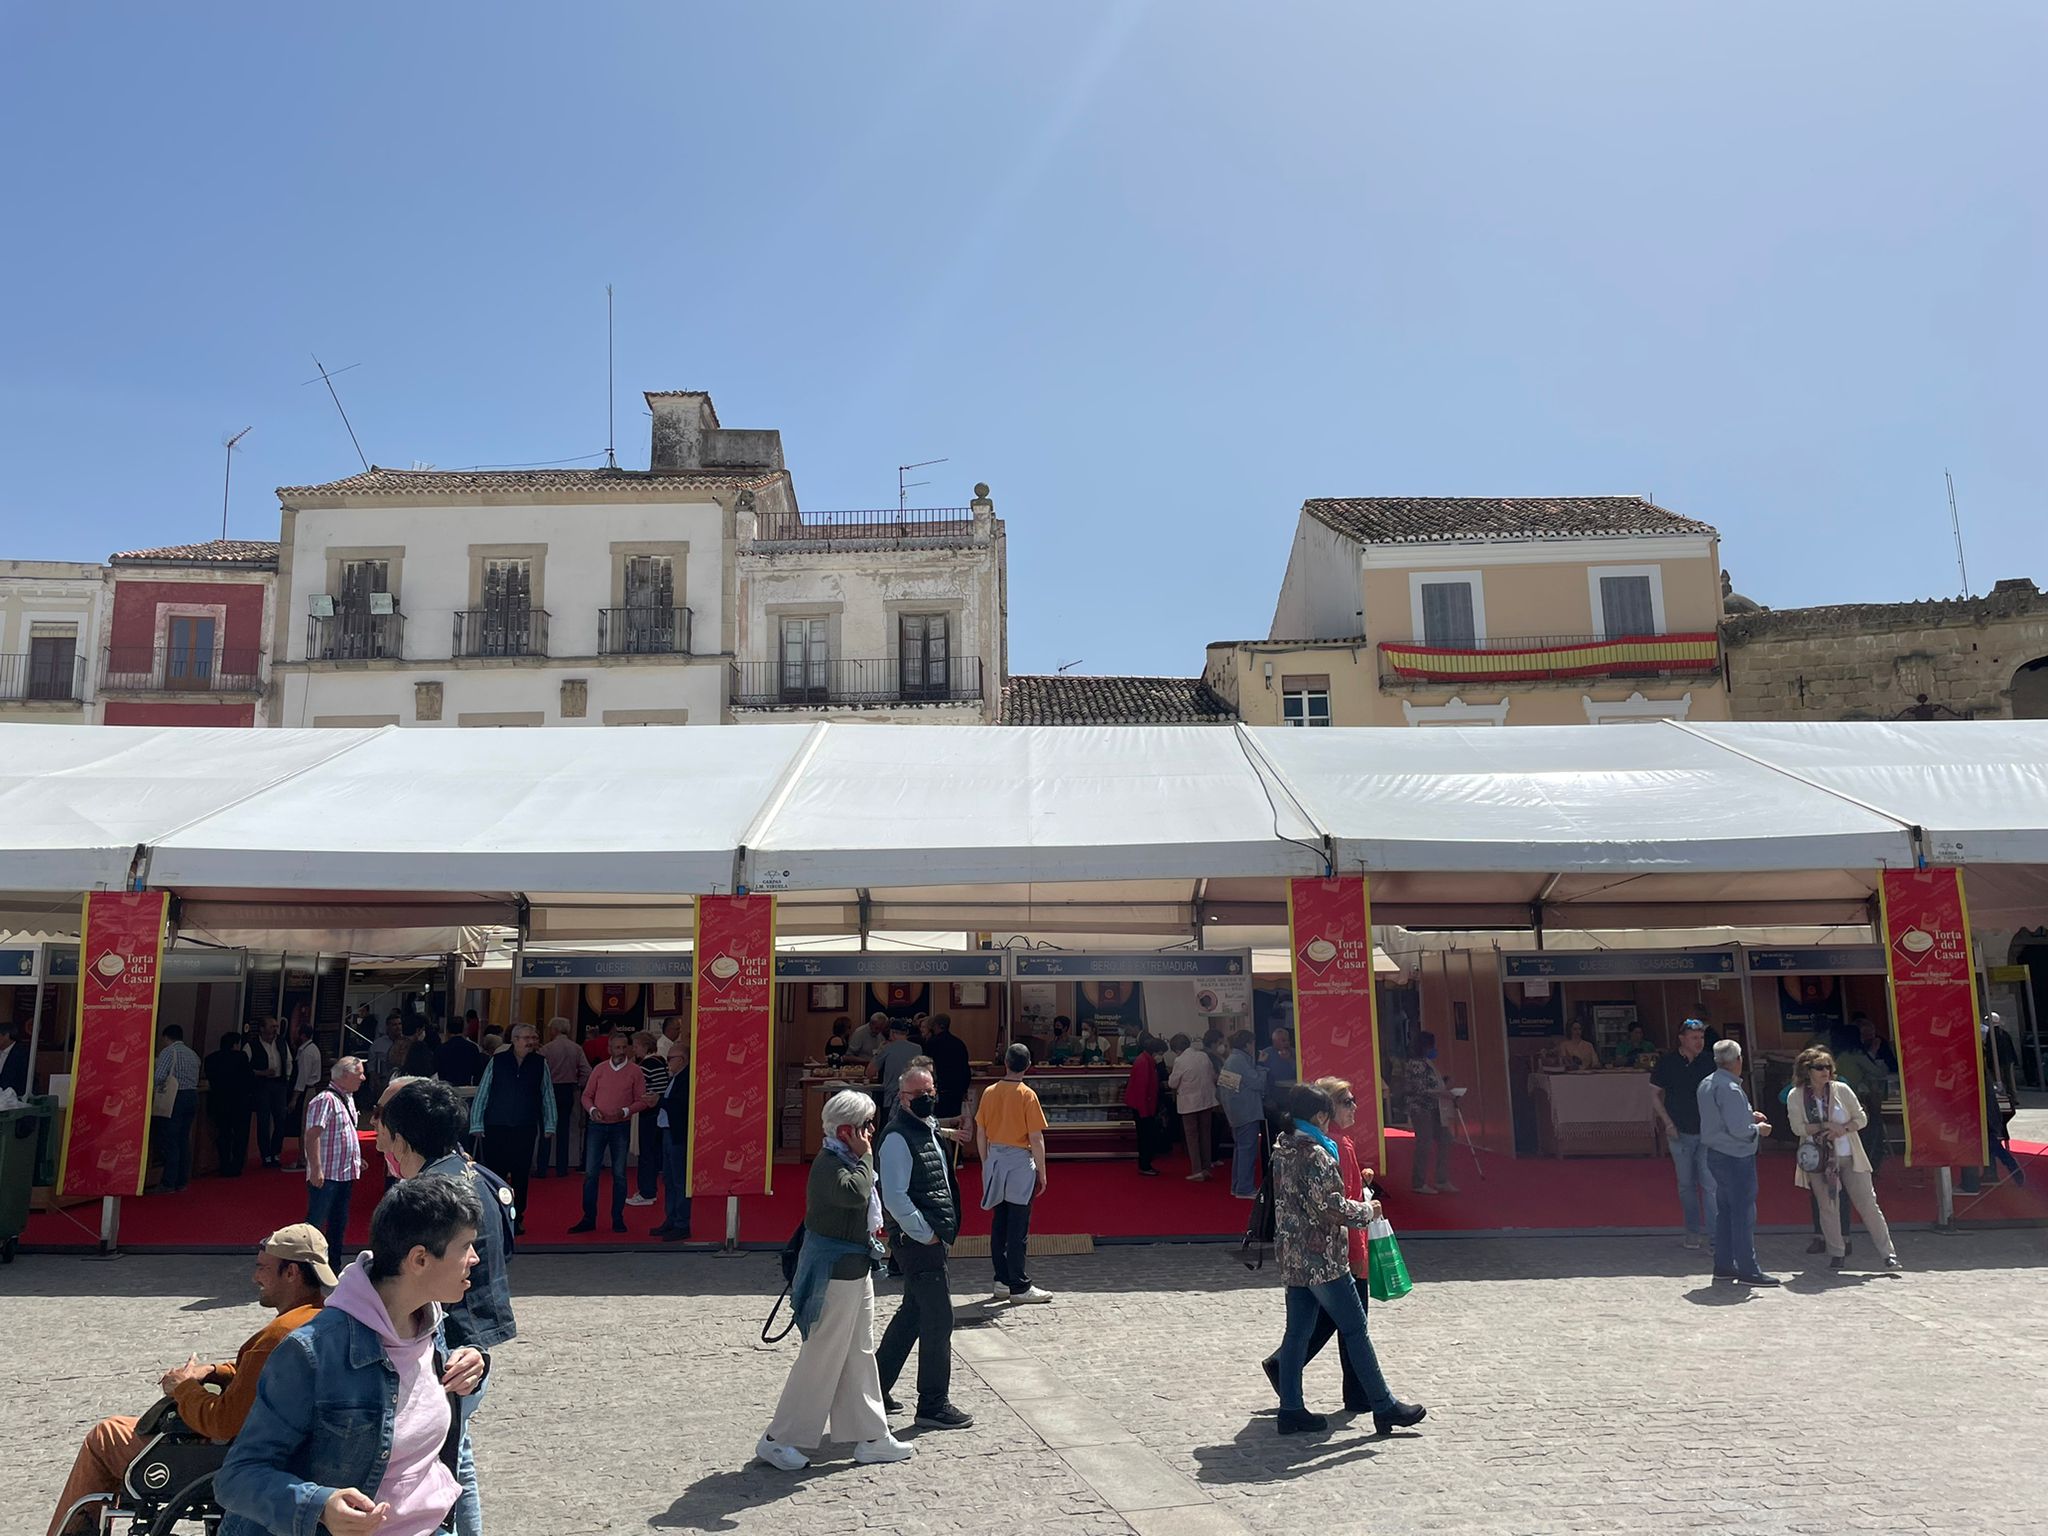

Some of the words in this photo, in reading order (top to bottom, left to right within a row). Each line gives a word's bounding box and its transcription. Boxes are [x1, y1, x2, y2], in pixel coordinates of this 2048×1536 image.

[1933, 929, 1961, 939] Torta
[1338, 939, 1363, 949] Torta
[1941, 940, 1956, 949] del
[127, 953, 154, 963] Torta
[1343, 949, 1358, 959] del
[1934, 950, 1966, 960] Casar
[741, 956, 767, 966] Torta
[856, 960, 900, 972] QUESERA
[1337, 959, 1366, 969] Casar
[131, 964, 147, 974] del
[595, 961, 640, 973] QUESER
[668, 961, 692, 972] FRAN
[746, 966, 761, 976] del
[123, 974, 154, 984] Casar
[738, 976, 769, 986] Casar
